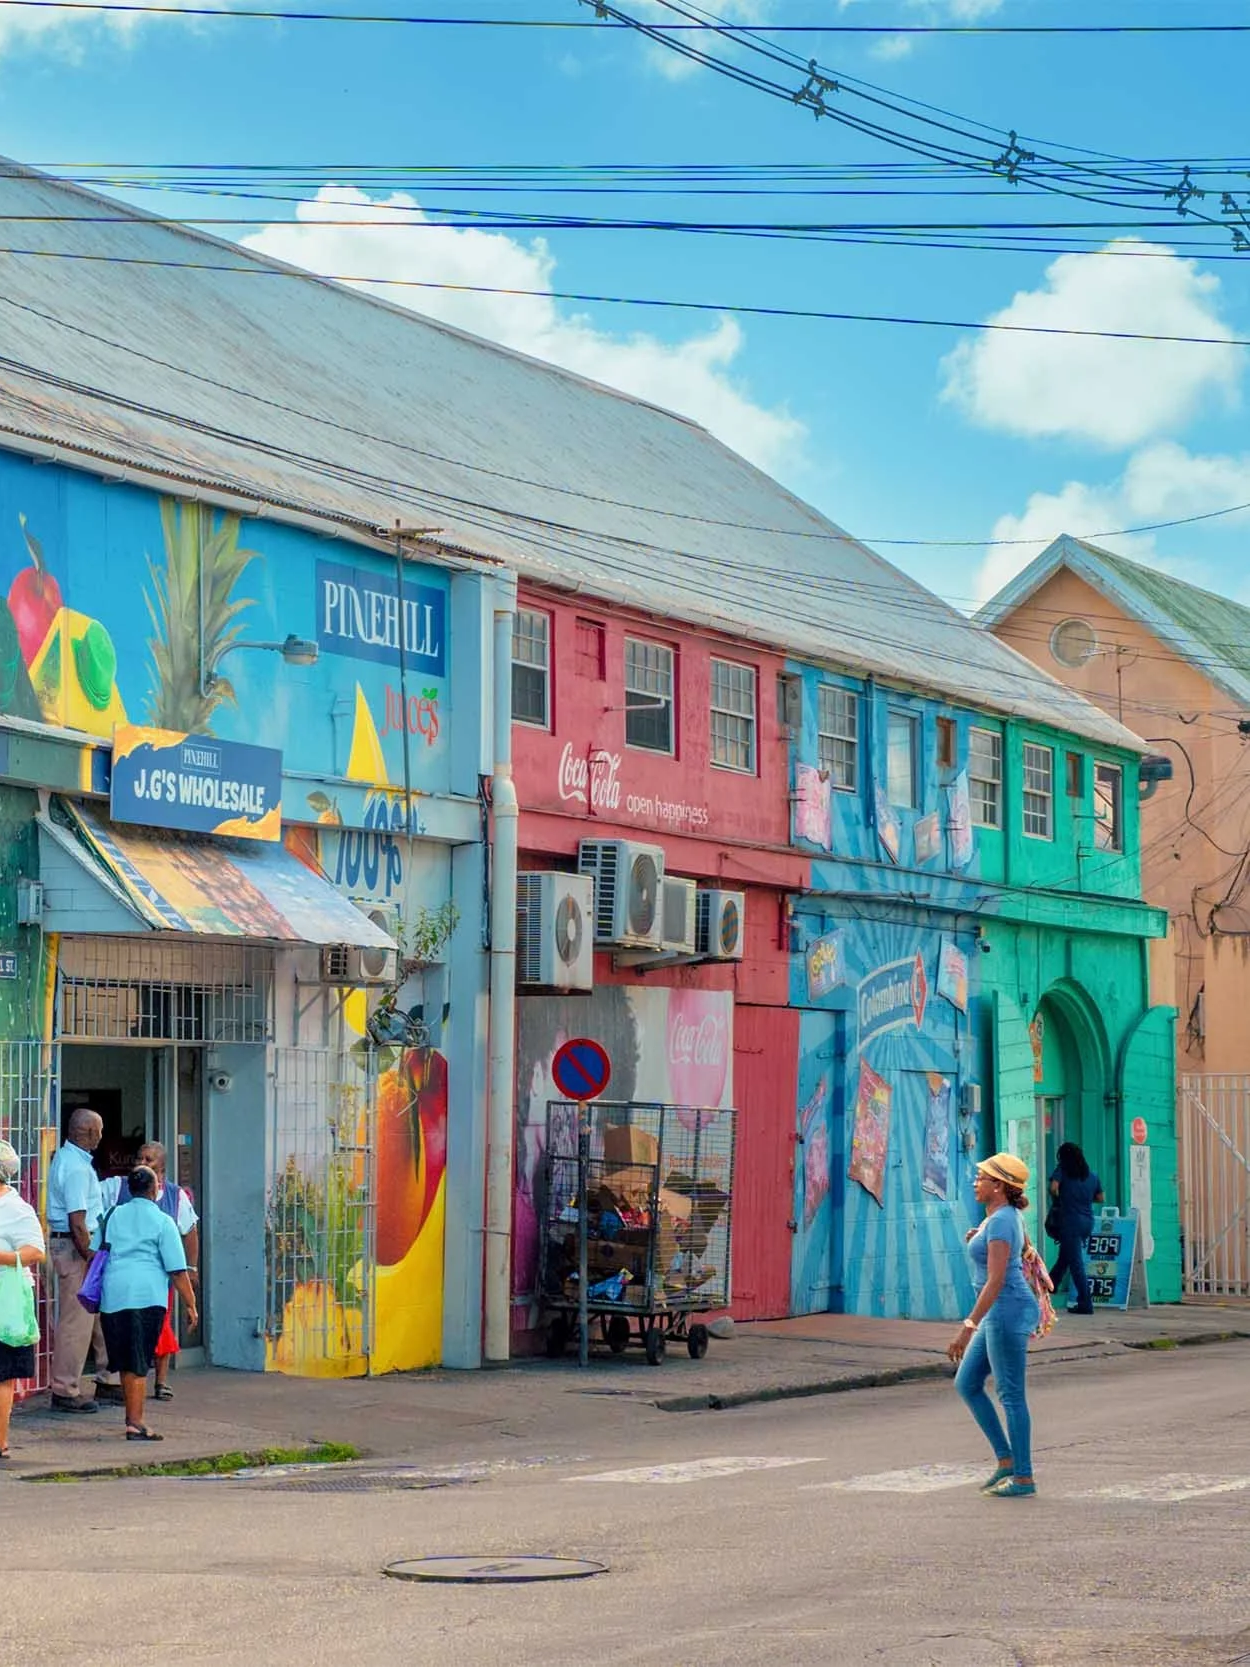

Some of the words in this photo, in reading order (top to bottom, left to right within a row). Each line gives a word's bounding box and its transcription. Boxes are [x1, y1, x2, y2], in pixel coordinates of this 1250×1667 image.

[323, 580, 438, 658] PINEHILL
[380, 683, 440, 746] Juces
[183, 748, 219, 769] PINEHILL
[134, 768, 176, 802] J.G'S
[179, 773, 265, 815] WHOLESALE
[626, 793, 653, 816] open
[655, 794, 709, 824] happiness
